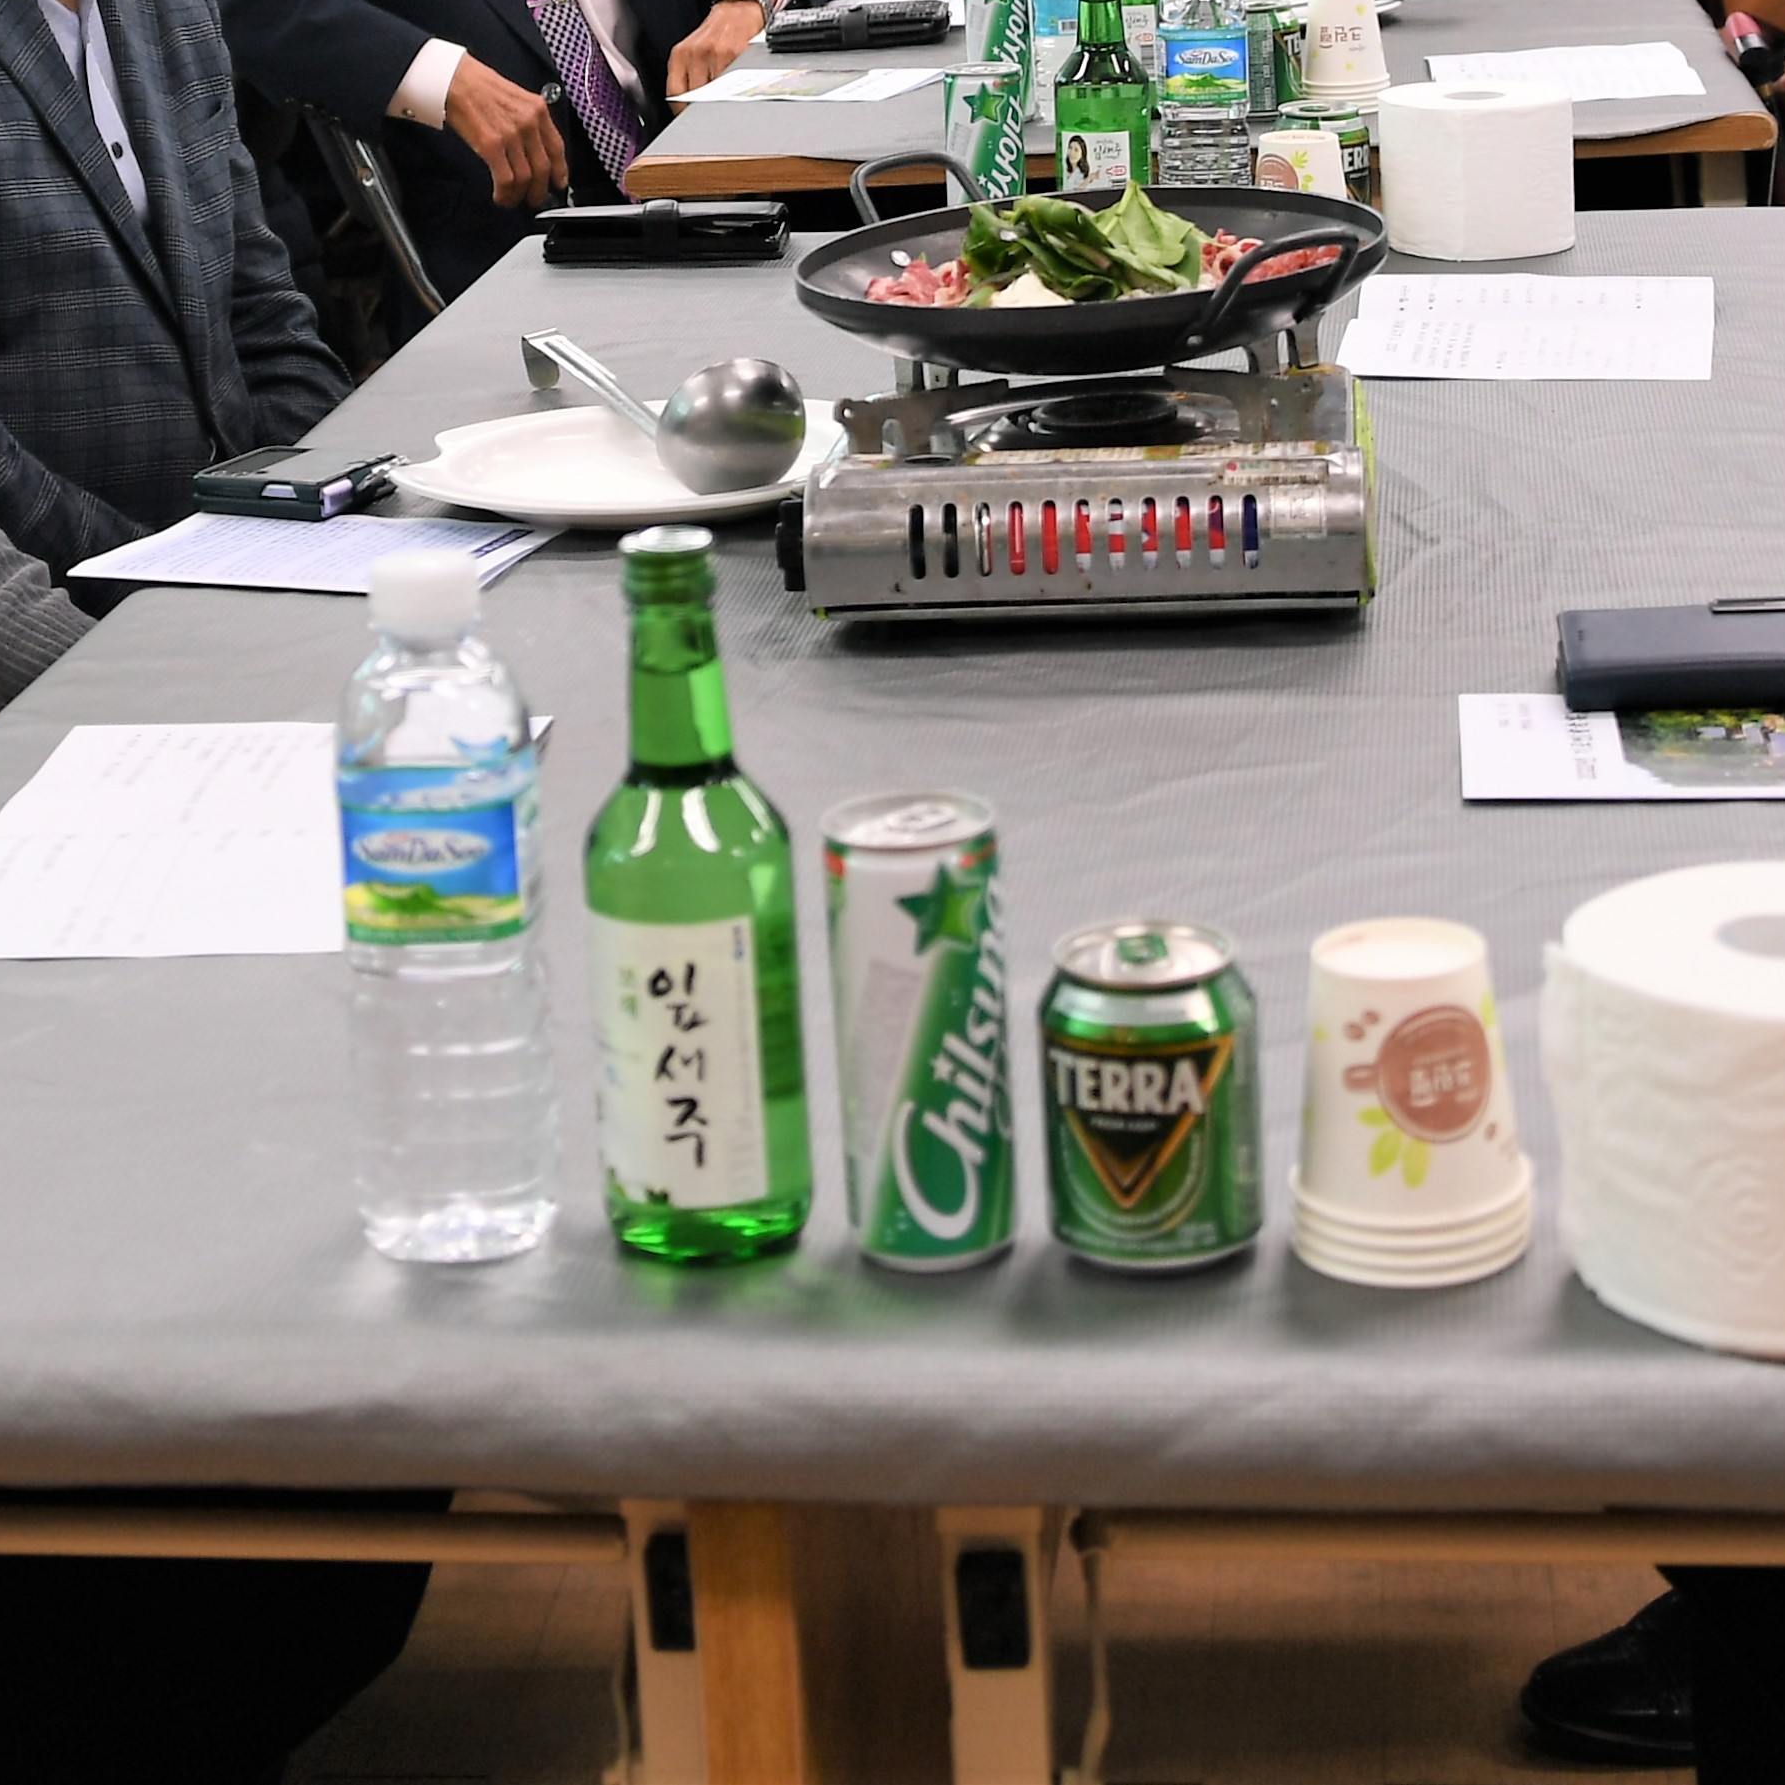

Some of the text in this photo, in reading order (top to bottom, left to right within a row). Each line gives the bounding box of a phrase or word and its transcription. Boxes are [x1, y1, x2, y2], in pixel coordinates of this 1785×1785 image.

[1342, 143, 1370, 173] ERR
[646, 962, 709, 1169] 잎새주
[1048, 1047, 1206, 1116] TERRA
